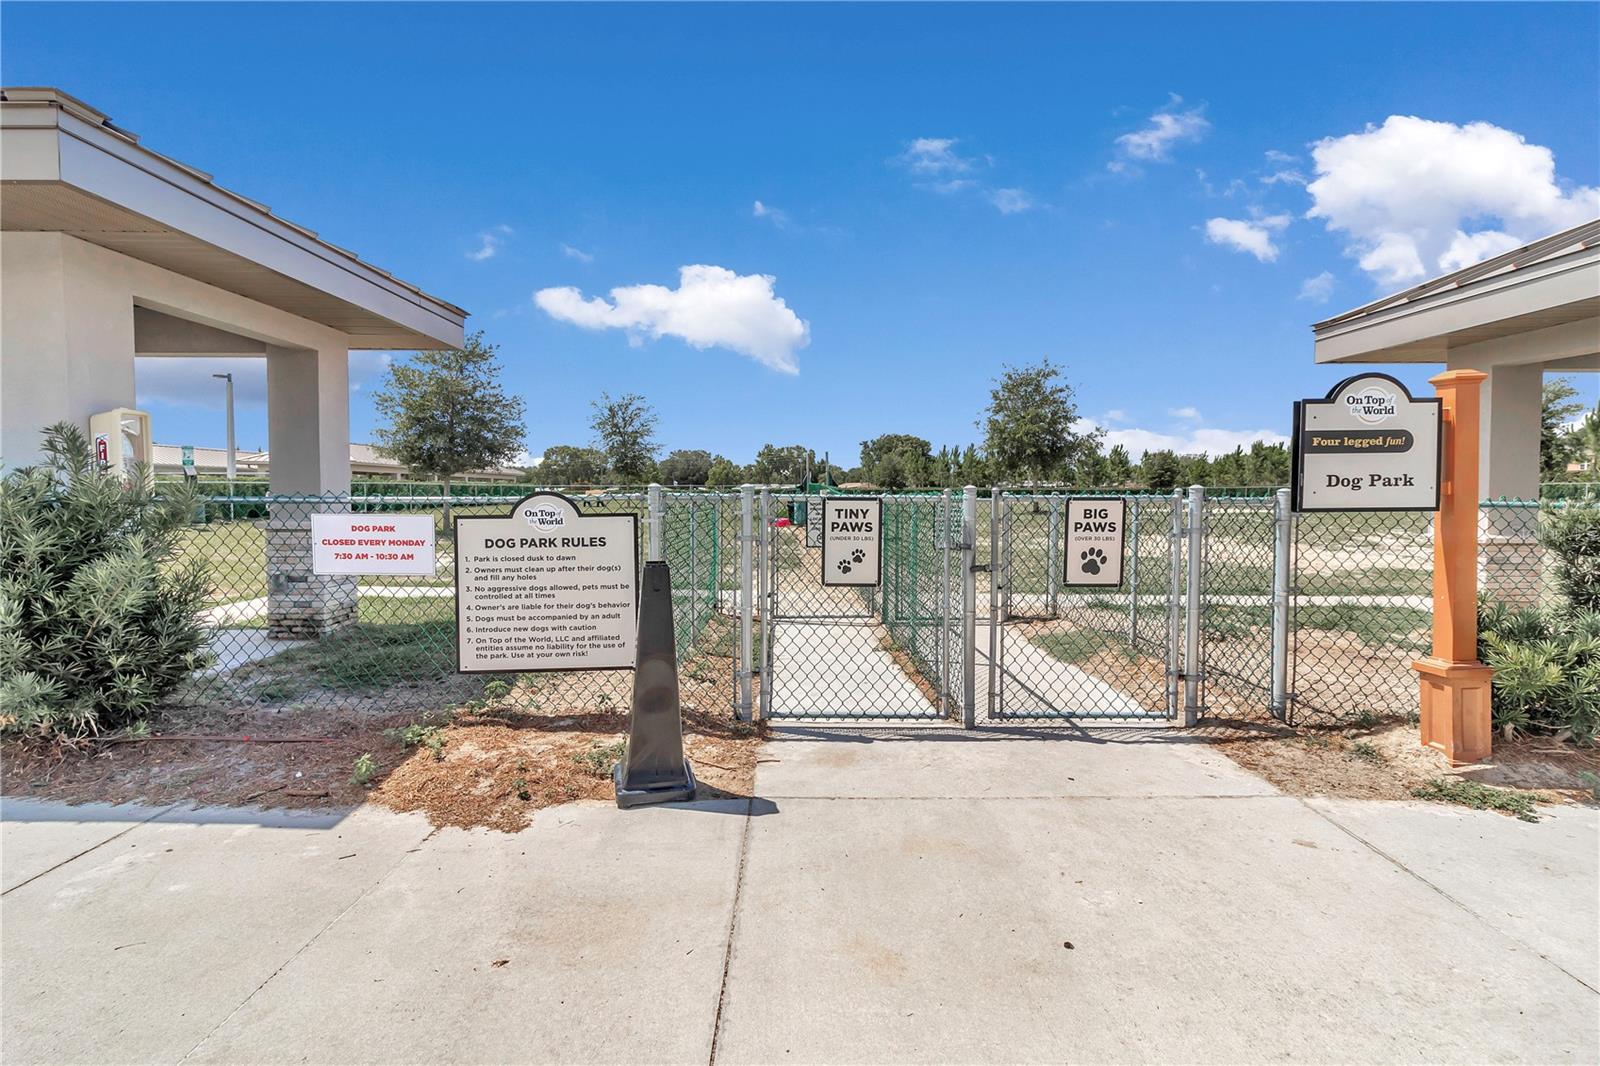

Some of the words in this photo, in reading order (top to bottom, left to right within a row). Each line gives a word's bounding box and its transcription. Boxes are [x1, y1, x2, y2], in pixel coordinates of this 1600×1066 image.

[1347, 396, 1362, 404] On
[1364, 396, 1385, 406] Top
[1386, 396, 1394, 405] of
[1363, 406, 1394, 415] World
[1312, 438, 1341, 446] Four
[1344, 437, 1382, 448] legged
[1384, 437, 1405, 448] fun!
[1326, 474, 1363, 490] Dog
[1369, 474, 1414, 487] Park
[539, 510, 555, 519] Top
[835, 509, 869, 519] TINY
[1084, 509, 1108, 519] BIG
[831, 522, 873, 532] PAWS
[1074, 522, 1116, 532] PAWS
[485, 538, 516, 548] DOG
[520, 538, 557, 548] PARK
[562, 537, 606, 547] RULES
[597, 565, 621, 573] dog(s)
[487, 585, 527, 593] aggressive
[528, 614, 577, 622] accompanied
